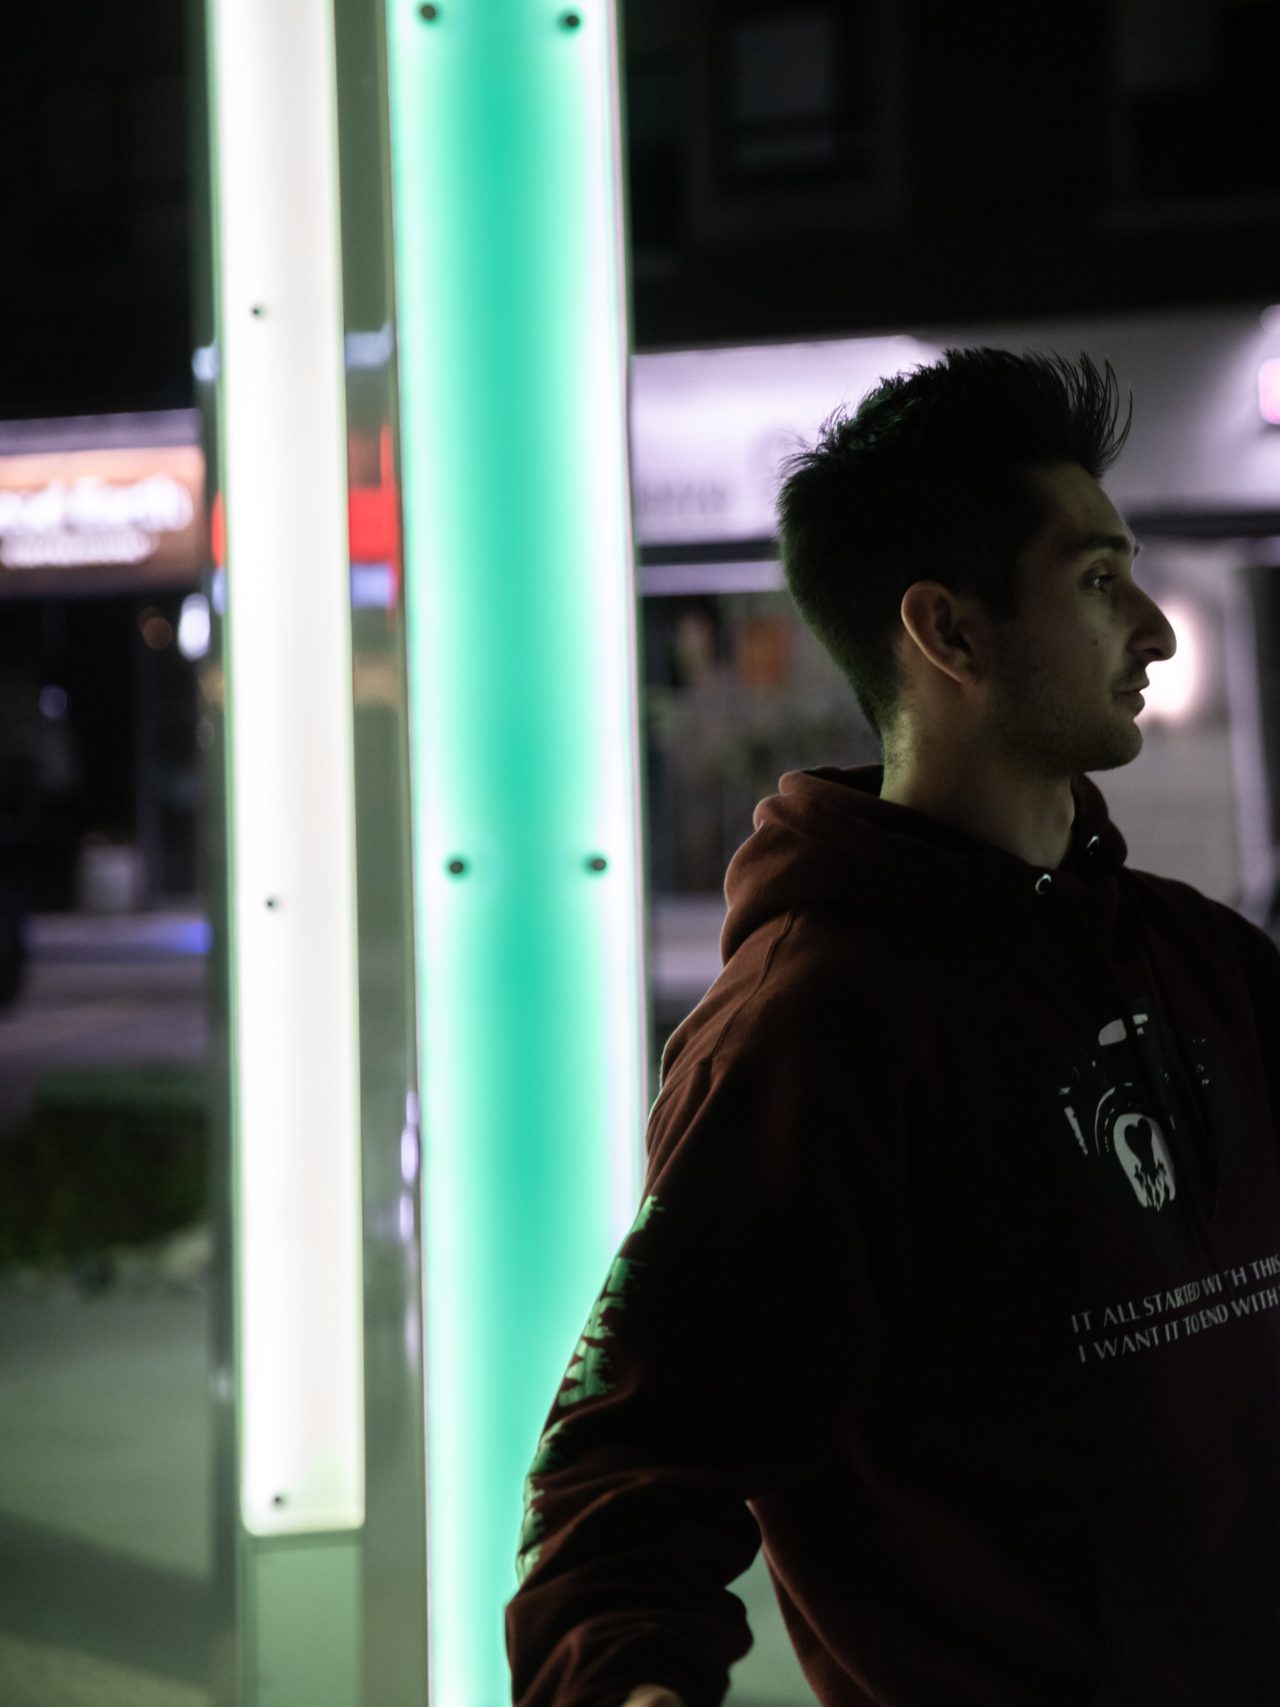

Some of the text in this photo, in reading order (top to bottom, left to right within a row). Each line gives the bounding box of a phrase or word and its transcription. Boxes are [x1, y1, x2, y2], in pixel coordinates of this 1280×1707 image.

[1071, 1310, 1092, 1334] IT
[1103, 1301, 1141, 1328] ALL
[1142, 1280, 1200, 1317] STARTED
[1078, 1343, 1087, 1364] I
[1093, 1325, 1160, 1361] WANT
[1163, 1320, 1180, 1343] IT
[1181, 1312, 1200, 1336] TO
[1199, 1303, 1229, 1330] END
[1230, 1286, 1279, 1319] WITH
